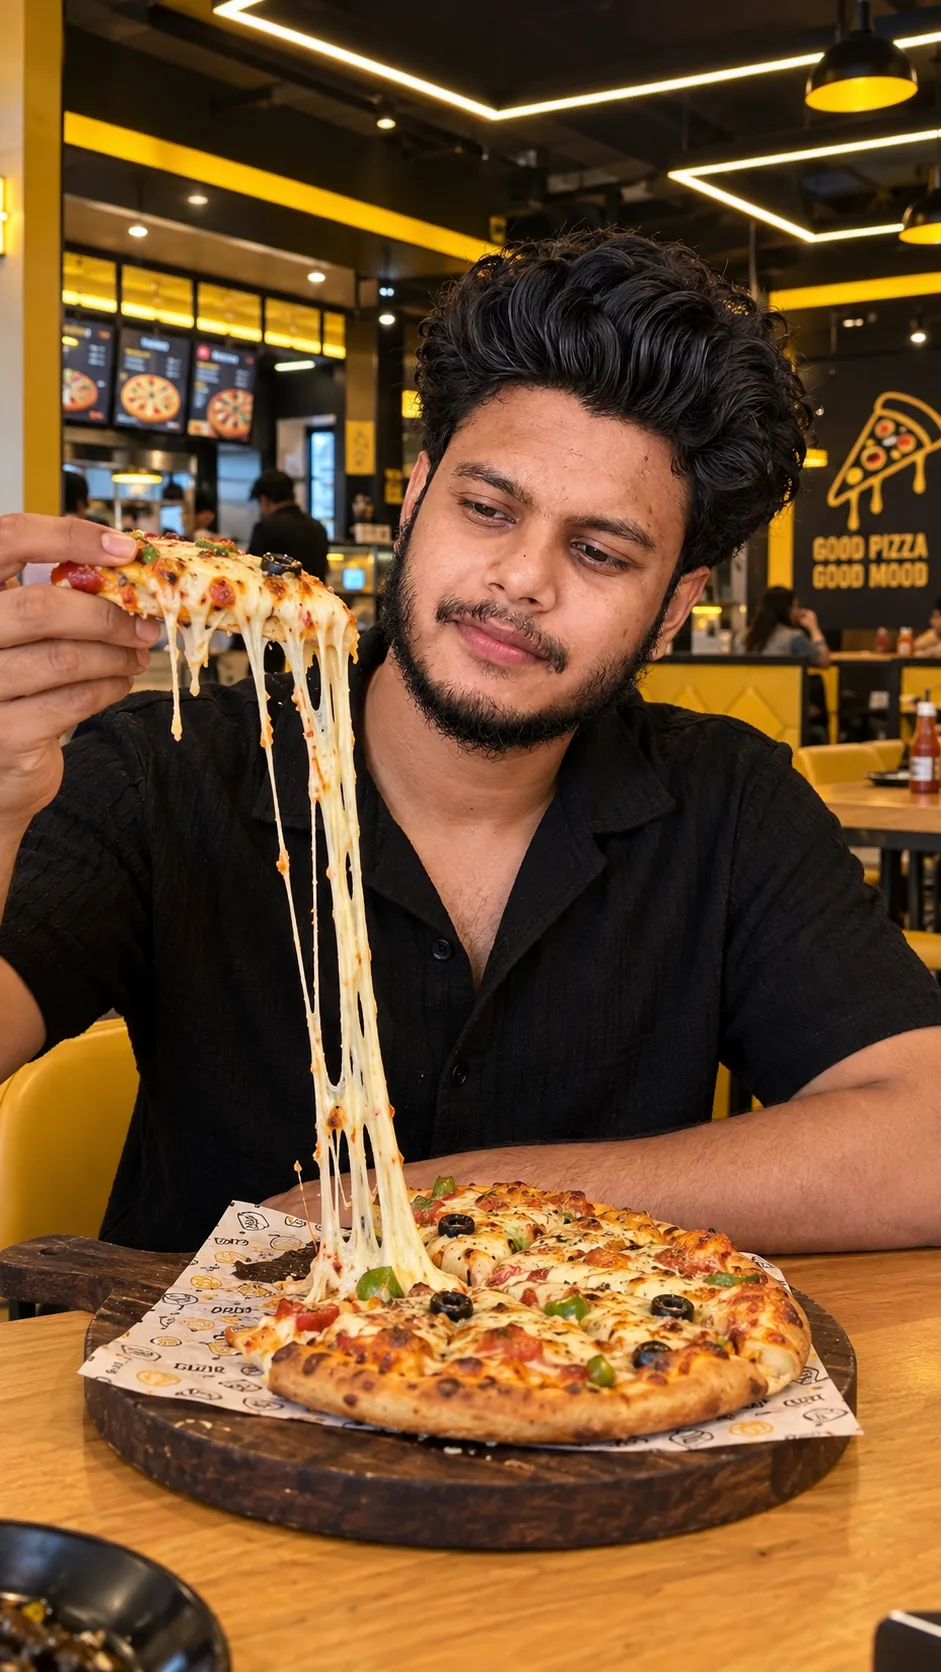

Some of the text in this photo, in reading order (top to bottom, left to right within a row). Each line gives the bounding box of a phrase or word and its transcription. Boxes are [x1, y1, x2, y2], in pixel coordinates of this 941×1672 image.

[812, 533, 929, 562] GOOD PIZZA
[812, 561, 929, 589] GOOD MOOD
